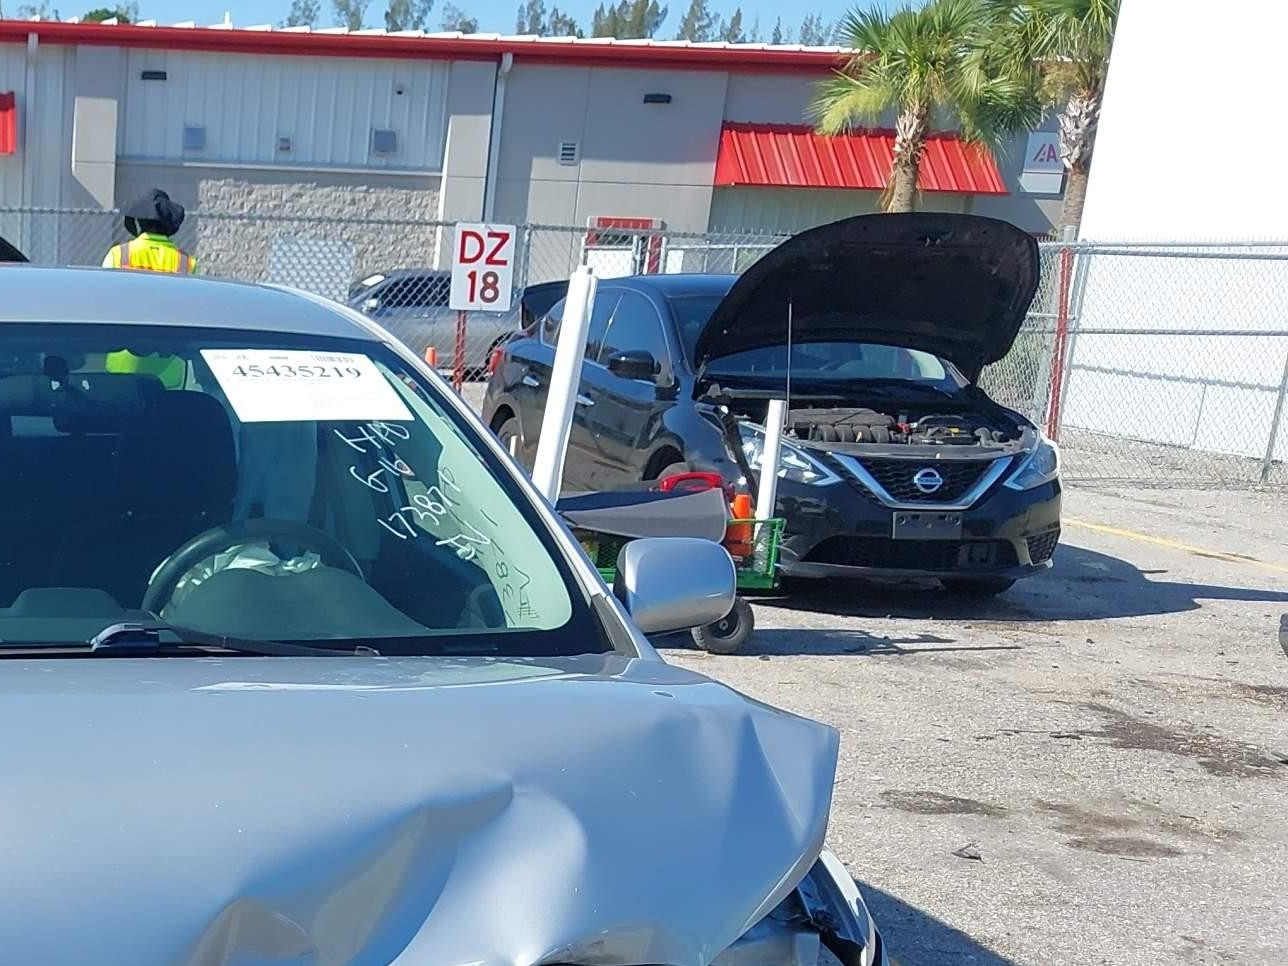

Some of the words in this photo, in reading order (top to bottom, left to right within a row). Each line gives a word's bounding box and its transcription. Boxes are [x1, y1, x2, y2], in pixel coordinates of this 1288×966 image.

[459, 230, 510, 265] DZ
[467, 270, 499, 303] 18
[232, 364, 362, 379] 45435219
